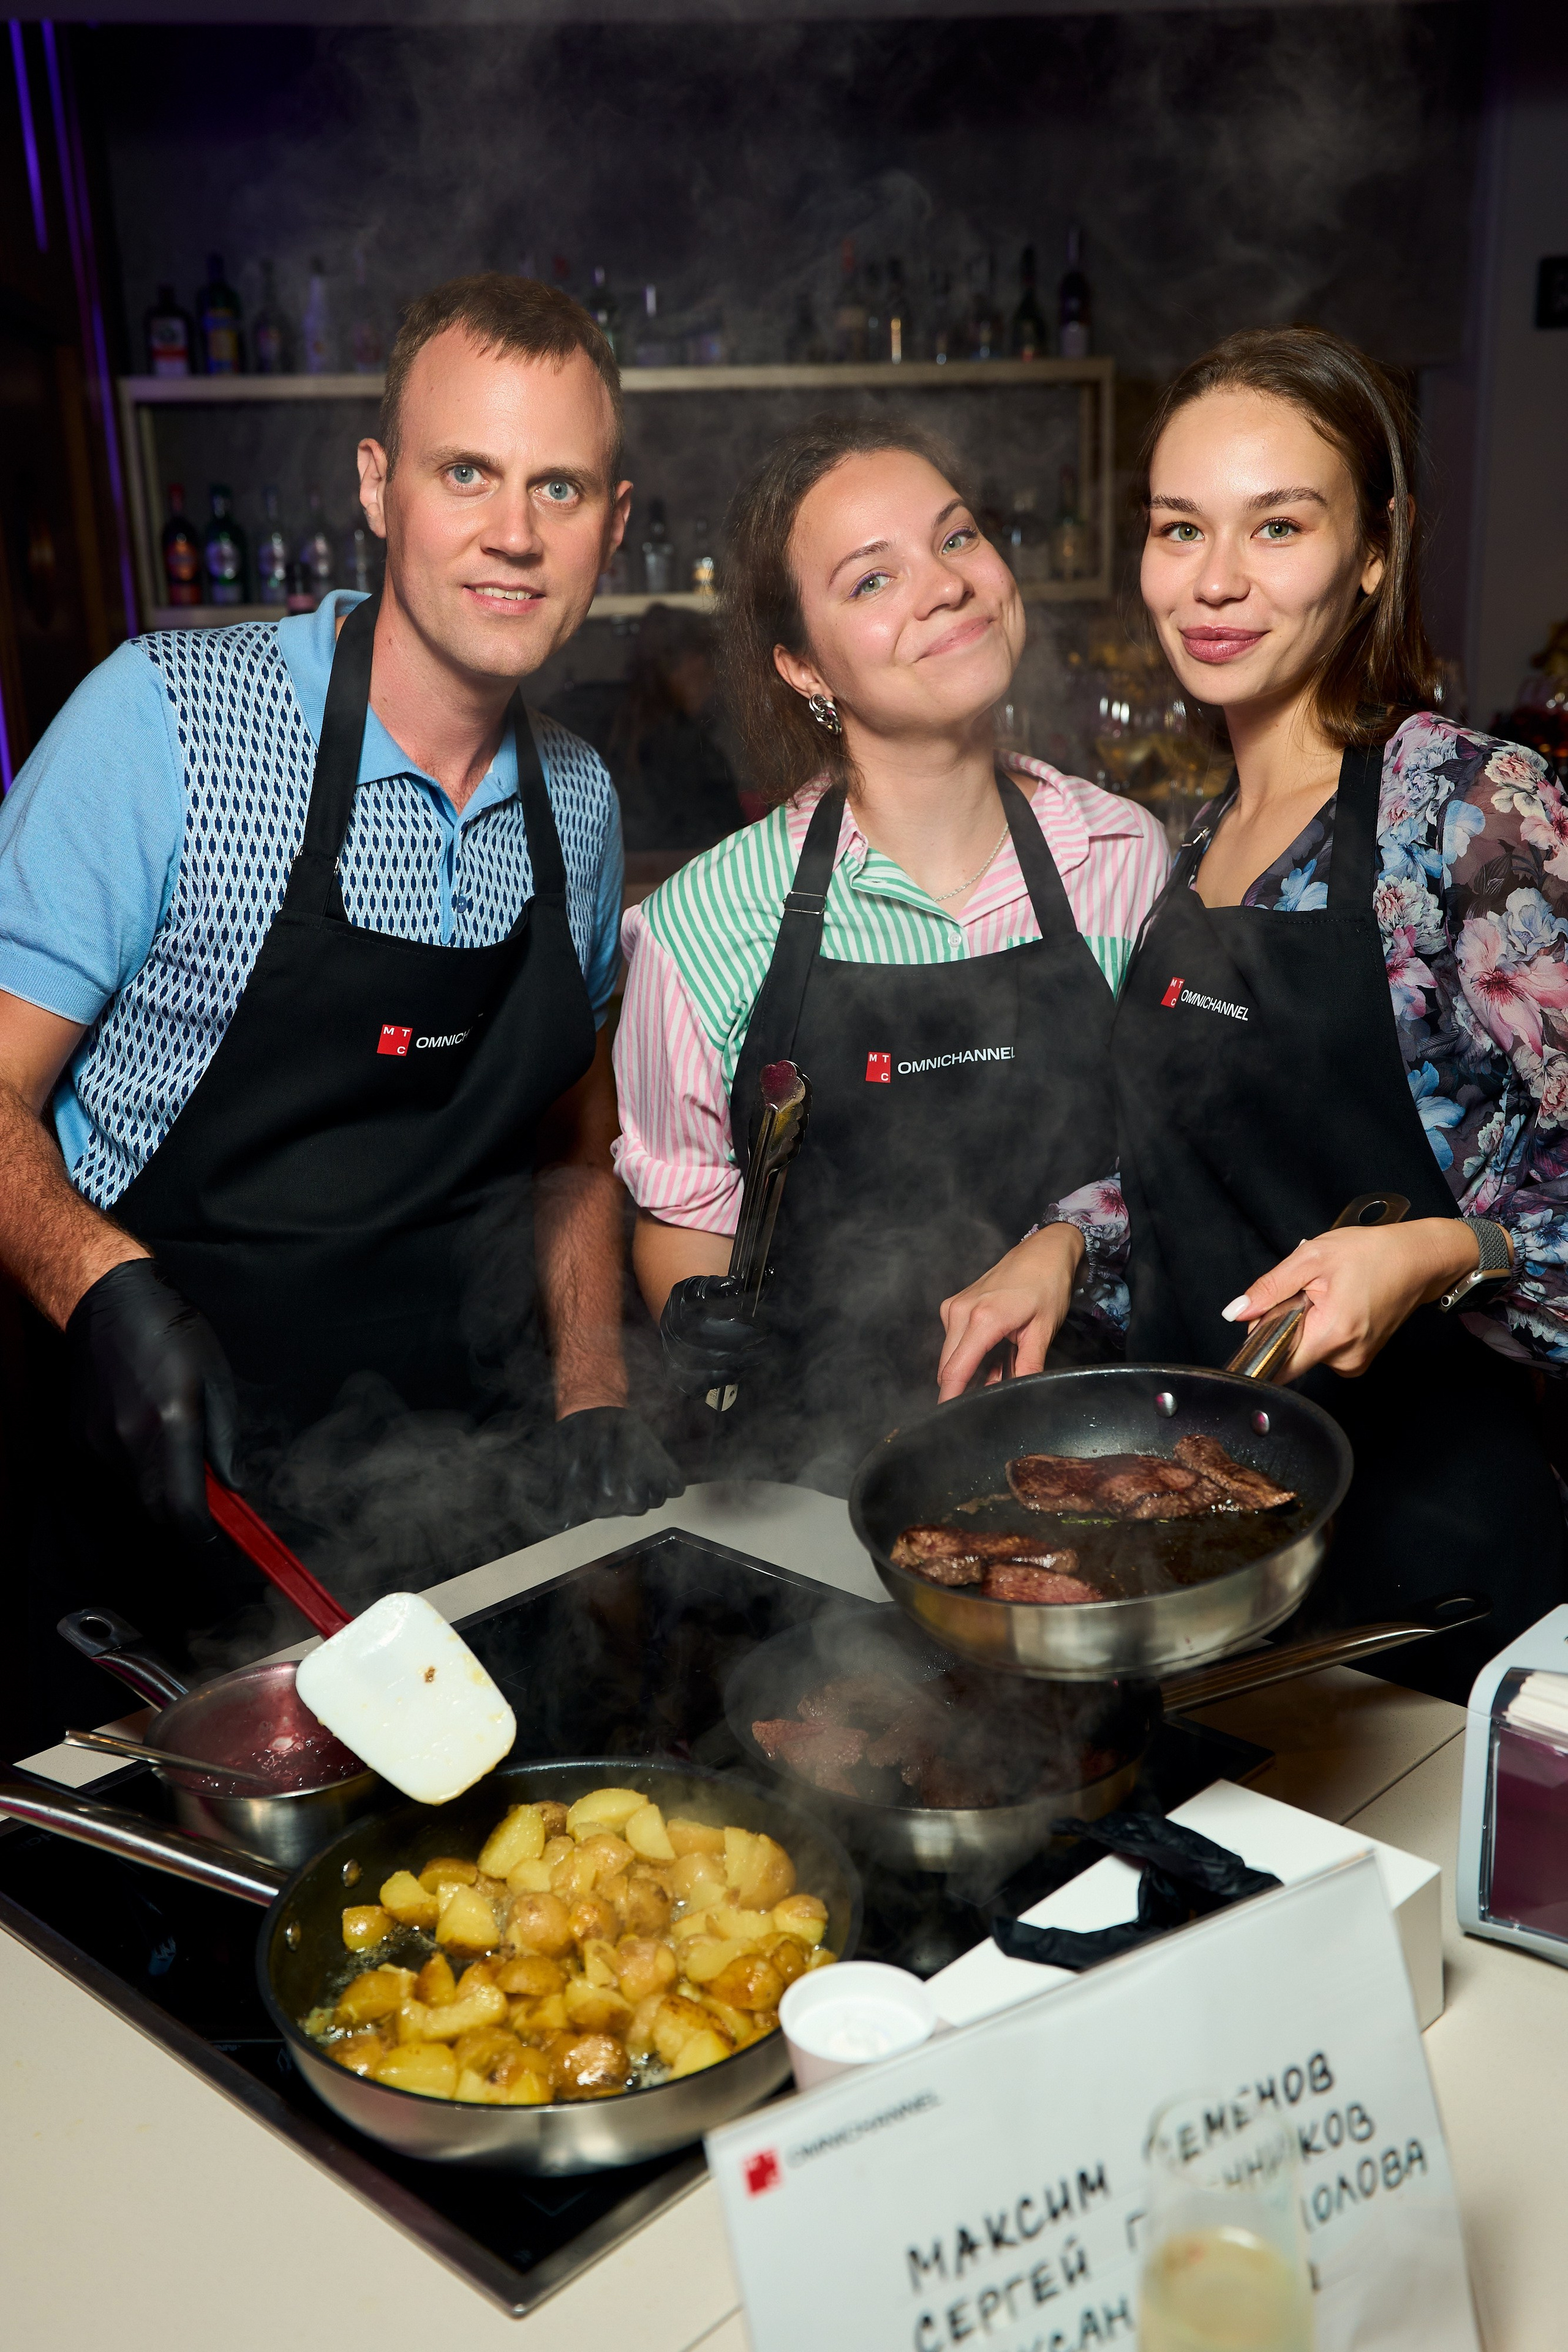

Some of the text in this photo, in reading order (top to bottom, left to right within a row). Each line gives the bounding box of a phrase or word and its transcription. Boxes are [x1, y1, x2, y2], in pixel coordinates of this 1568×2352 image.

[1180, 989, 1249, 1022] OMNICHANNEL
[897, 1046, 1016, 1074] OMNICHANNEL
[908, 2160, 1110, 2294] МАКСИМ
[914, 2233, 1091, 2352] СЕРГЕЙ
